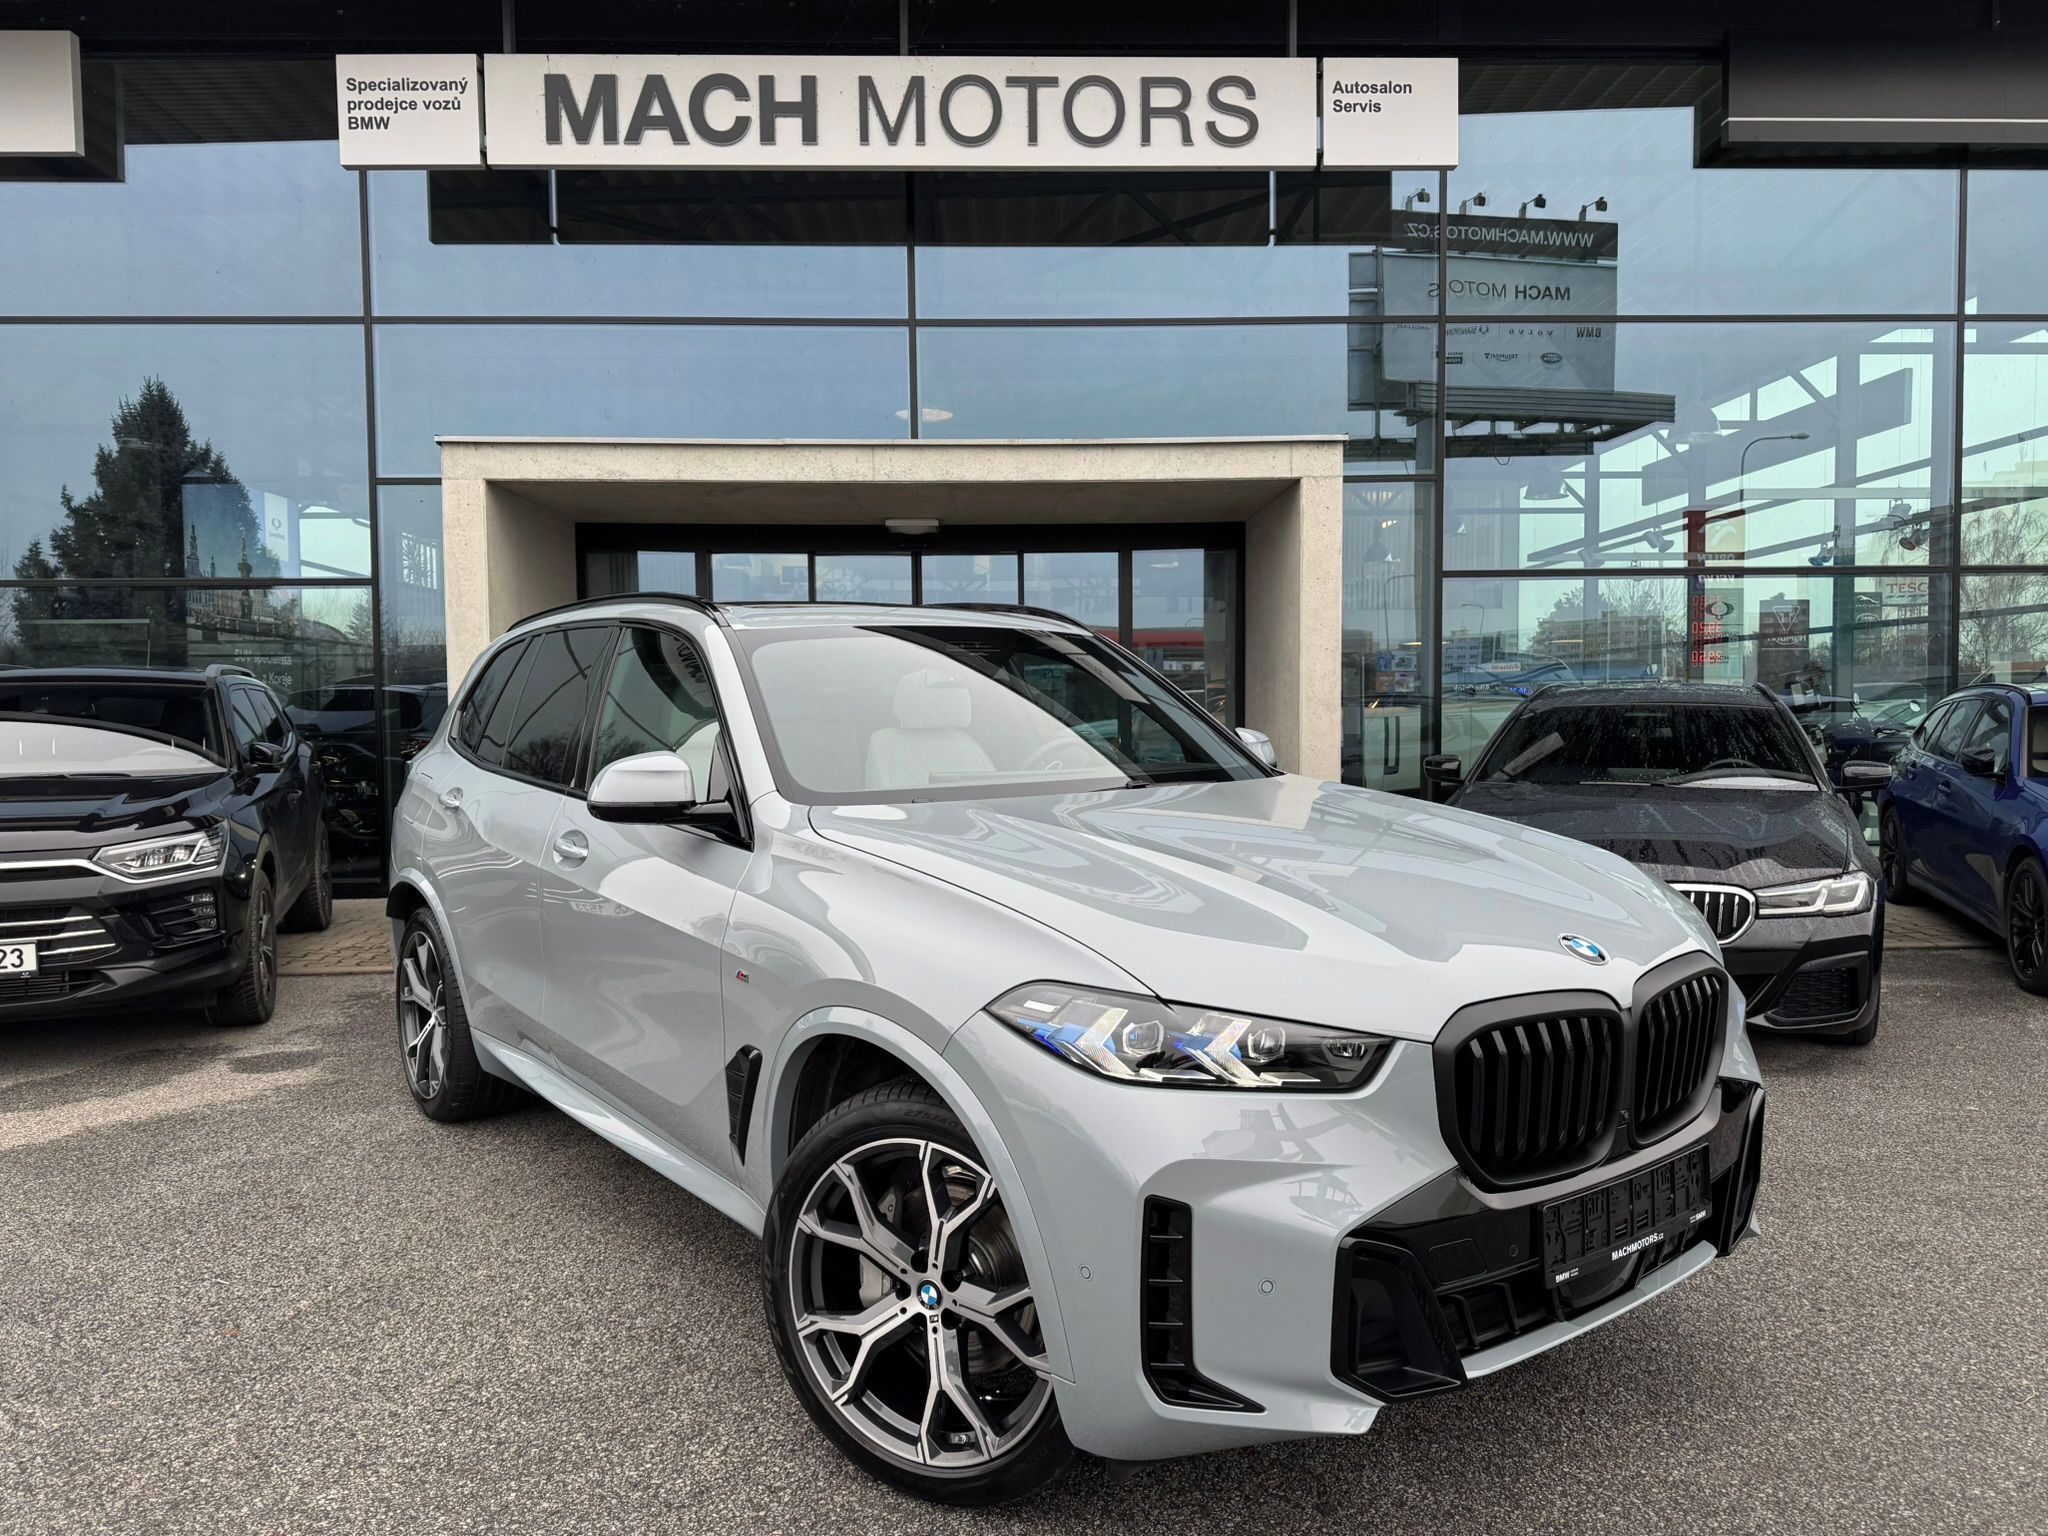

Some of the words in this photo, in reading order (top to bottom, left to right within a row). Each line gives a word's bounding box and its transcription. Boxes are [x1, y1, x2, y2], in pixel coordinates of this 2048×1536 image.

[345, 76, 469, 95] Specializovaný
[1332, 80, 1413, 95] Autosalon
[347, 95, 417, 114] prodejce
[421, 94, 462, 111] vozů
[544, 73, 818, 146] MACH
[858, 73, 1260, 148] MOTORS
[1332, 98, 1382, 113] Servis
[347, 116, 391, 130] BMW
[1886, 582, 1927, 594] TESC
[1611, 1232, 1664, 1261] MACHMOTORS.cz
[1555, 1271, 1571, 1283] BMW
